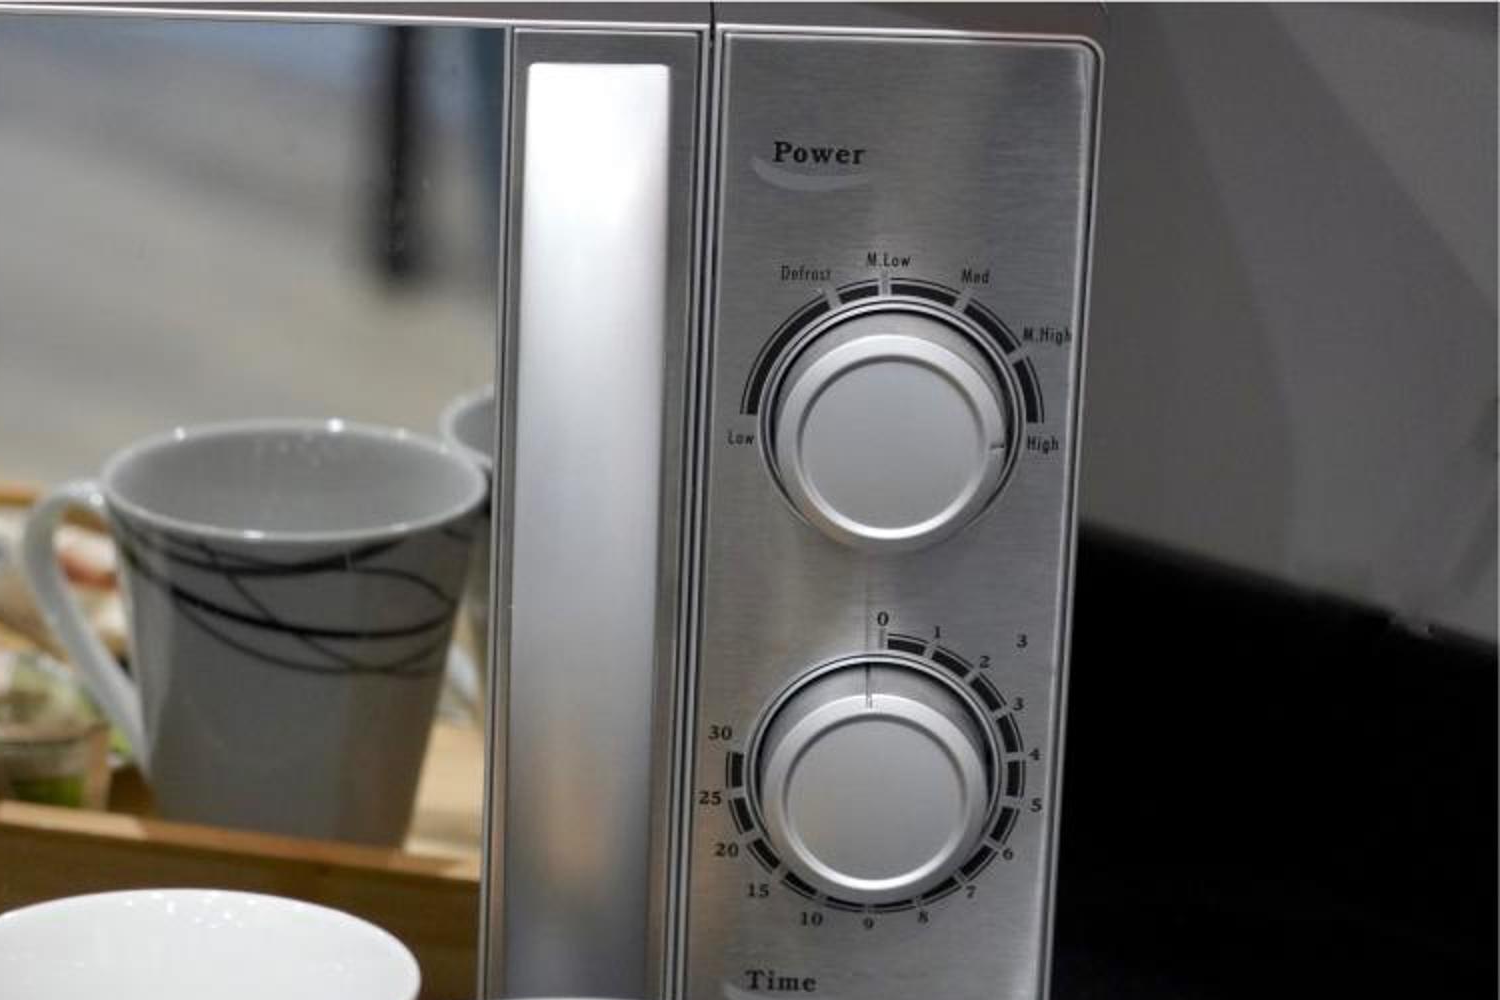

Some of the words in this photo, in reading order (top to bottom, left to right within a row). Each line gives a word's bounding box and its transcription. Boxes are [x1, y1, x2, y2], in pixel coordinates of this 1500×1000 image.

[772, 141, 867, 166] Power
[866, 252, 911, 268] M.Low
[780, 265, 832, 282] Defrost
[960, 269, 990, 285] Med
[1022, 327, 1072, 346] M.High
[727, 430, 754, 446] Low
[1026, 436, 1060, 454] High
[876, 610, 889, 626] 0
[933, 626, 942, 639] 1
[1016, 634, 1029, 648] 3
[978, 655, 991, 669] 2
[1012, 698, 1025, 712] 3
[708, 725, 732, 740] 30
[1029, 748, 1041, 761] 4
[699, 791, 722, 806] 25
[1030, 798, 1042, 813] 5
[716, 843, 739, 857] 20
[1002, 847, 1014, 862] 6
[747, 884, 770, 899] 15
[966, 886, 978, 899] 7
[799, 911, 824, 927] 10
[863, 917, 875, 931] 9
[917, 910, 930, 924] 8
[745, 969, 817, 994] Time
